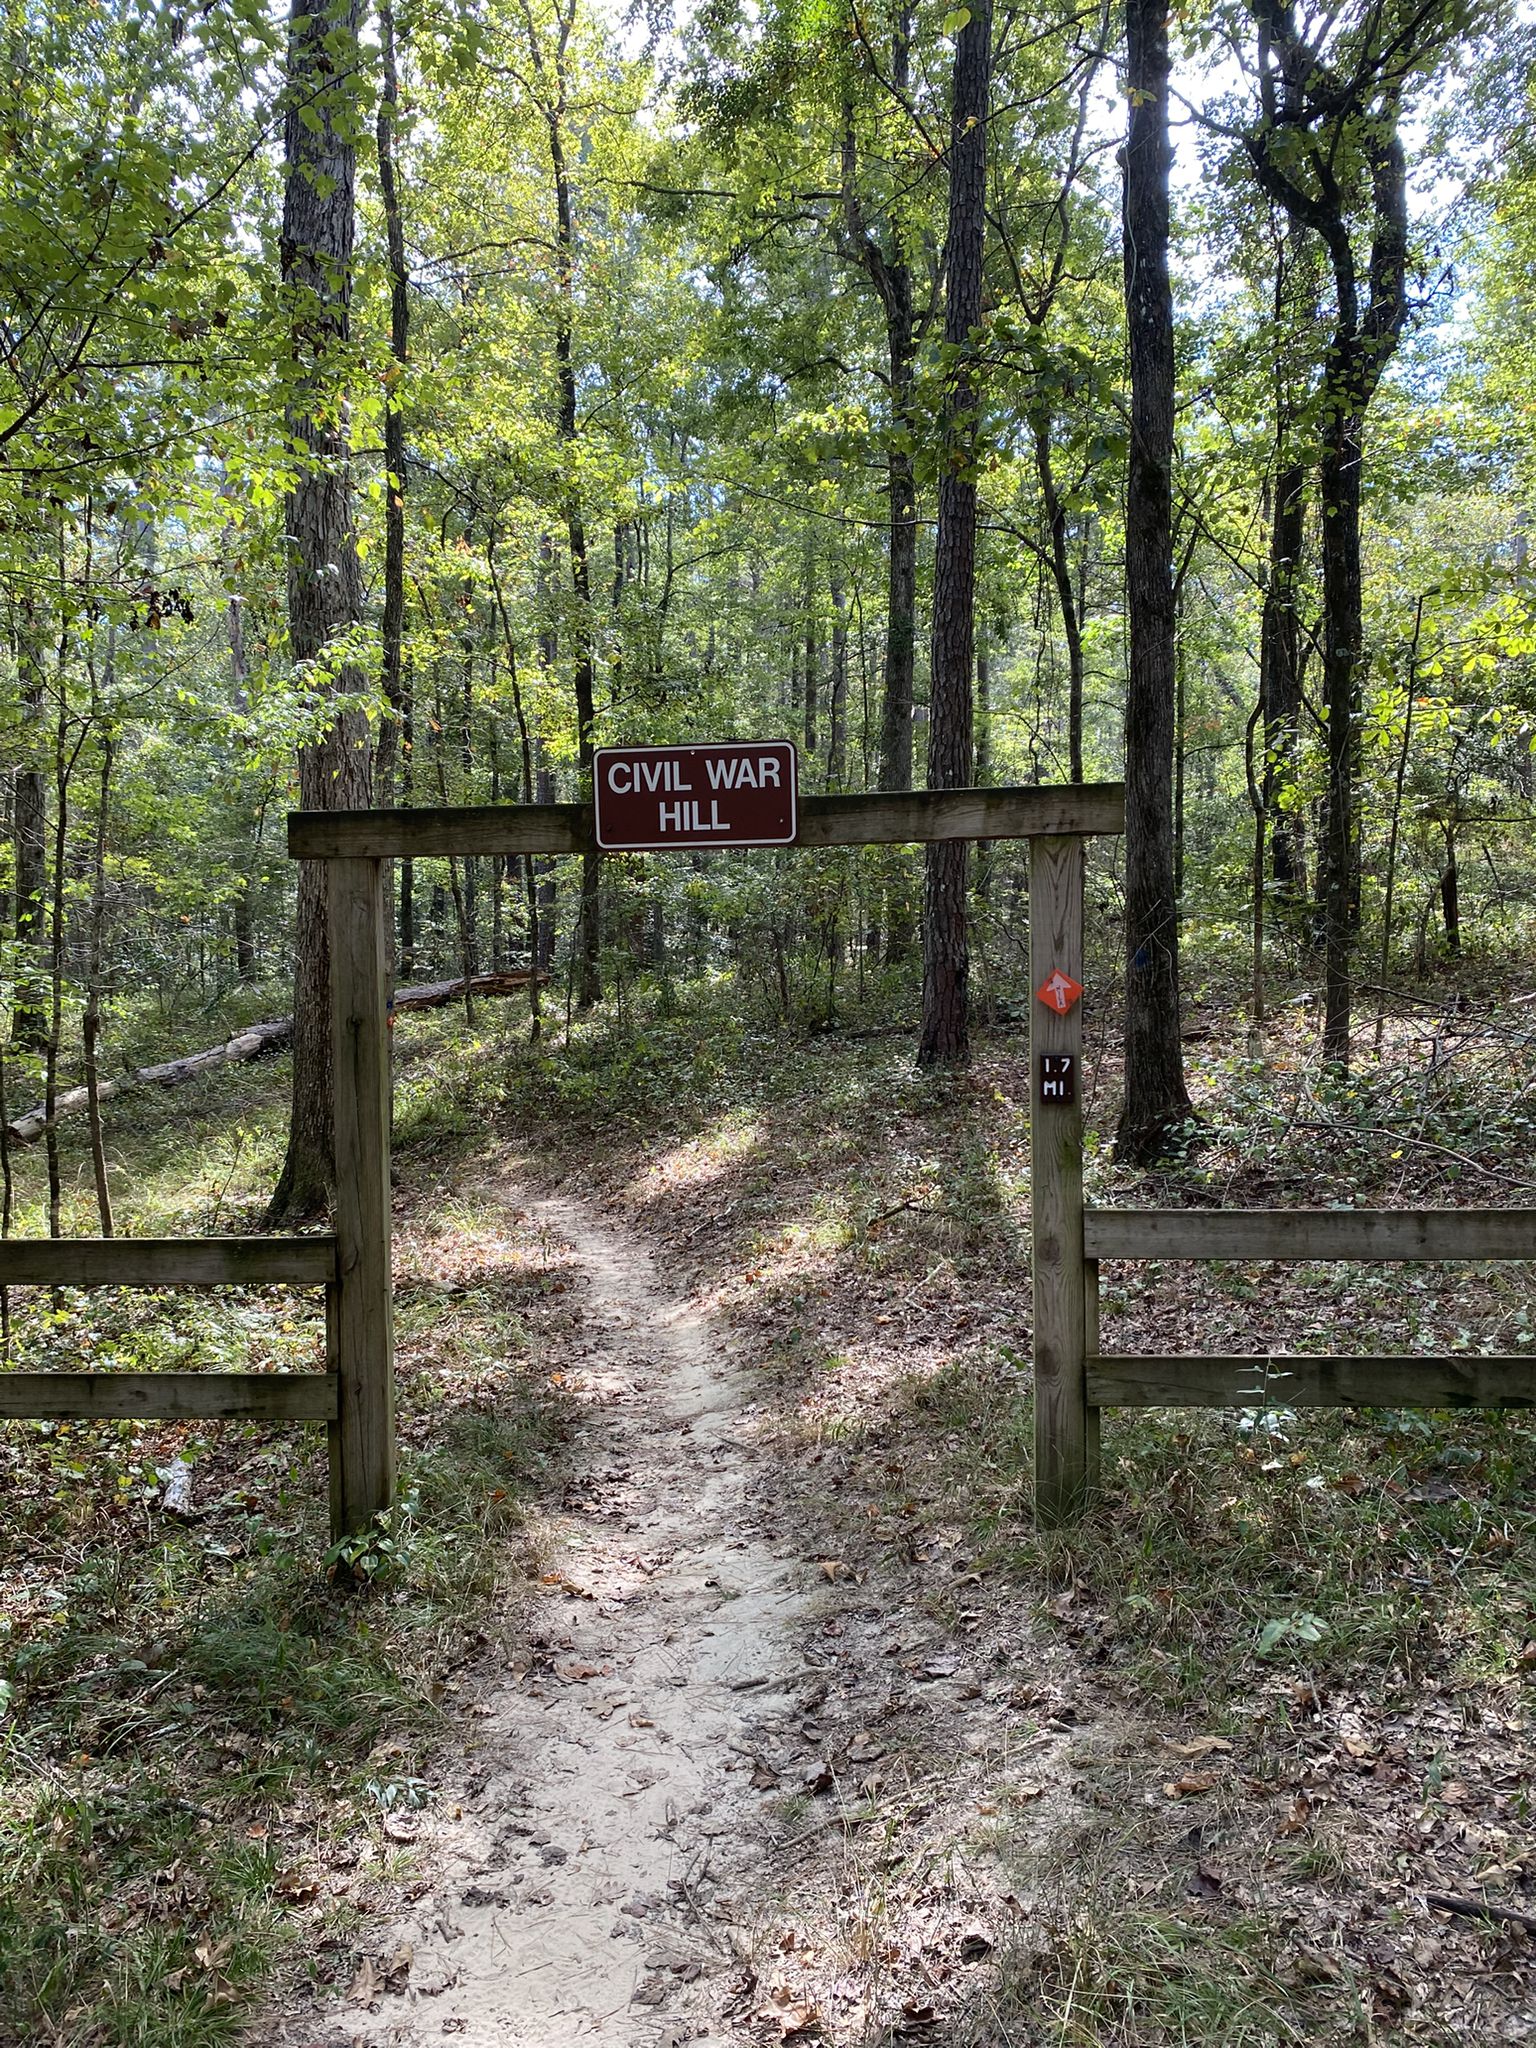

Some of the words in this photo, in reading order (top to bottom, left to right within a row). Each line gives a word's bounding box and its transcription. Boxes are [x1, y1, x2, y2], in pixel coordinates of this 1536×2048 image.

[607, 761, 692, 794] CIVIL
[705, 757, 781, 790] WAR
[659, 799, 731, 832] HILL
[1045, 1058, 1071, 1073] 1.7
